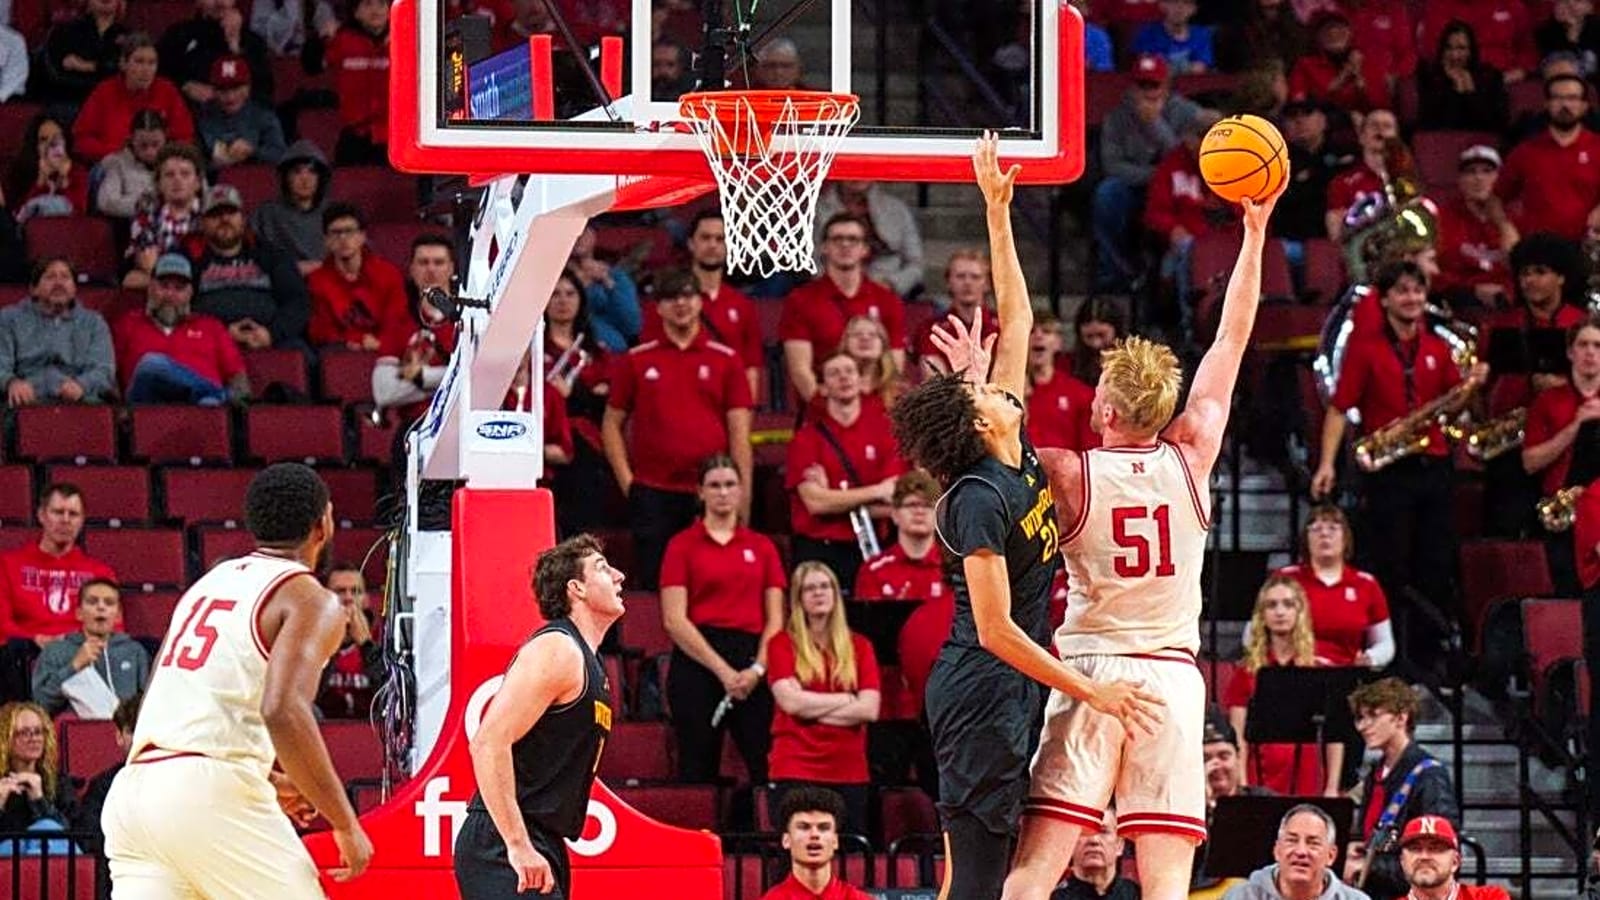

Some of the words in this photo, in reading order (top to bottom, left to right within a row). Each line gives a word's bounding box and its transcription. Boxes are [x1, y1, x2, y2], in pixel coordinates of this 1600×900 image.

[1132, 462, 1145, 474] N
[1112, 504, 1175, 578] 51
[161, 595, 237, 671] 15
[1420, 817, 1436, 834] N
